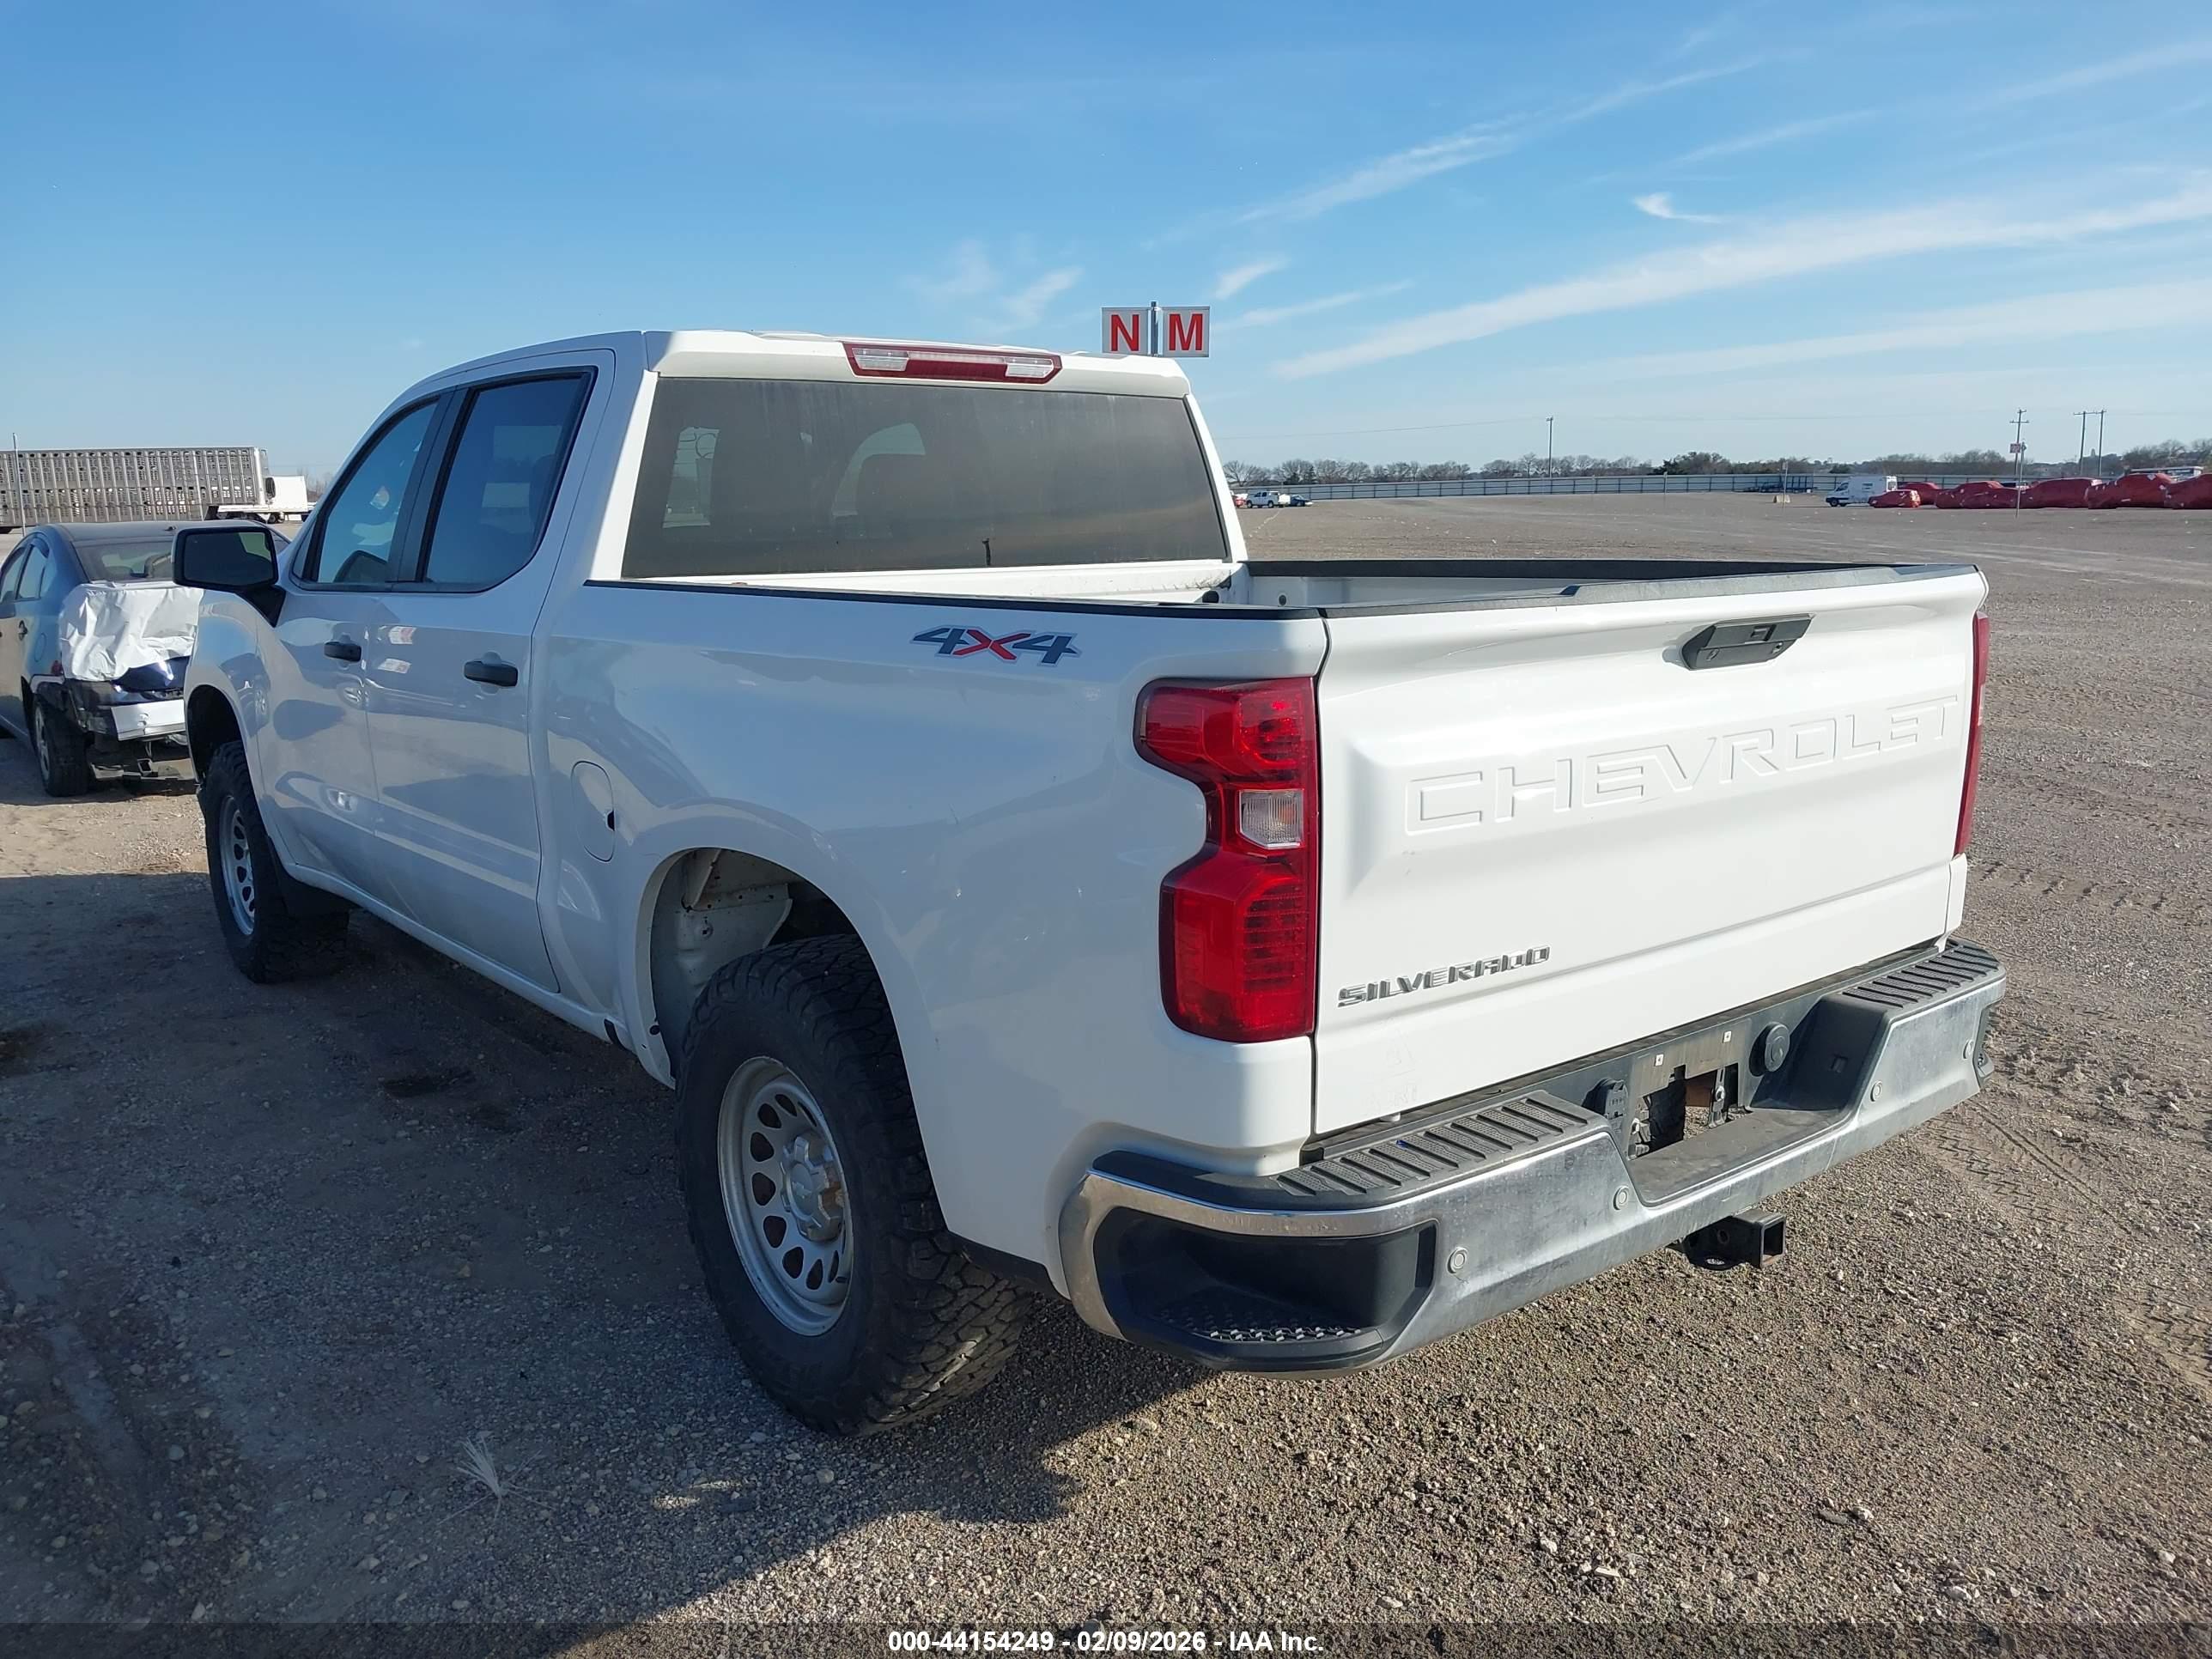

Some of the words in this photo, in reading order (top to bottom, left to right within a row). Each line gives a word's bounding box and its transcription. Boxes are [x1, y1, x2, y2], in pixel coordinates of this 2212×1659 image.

[1110, 313, 1139, 351] N
[1168, 313, 1203, 351] M
[1405, 693, 1959, 836] CHEVROLET
[1337, 945, 1551, 1008] SILVERADO
